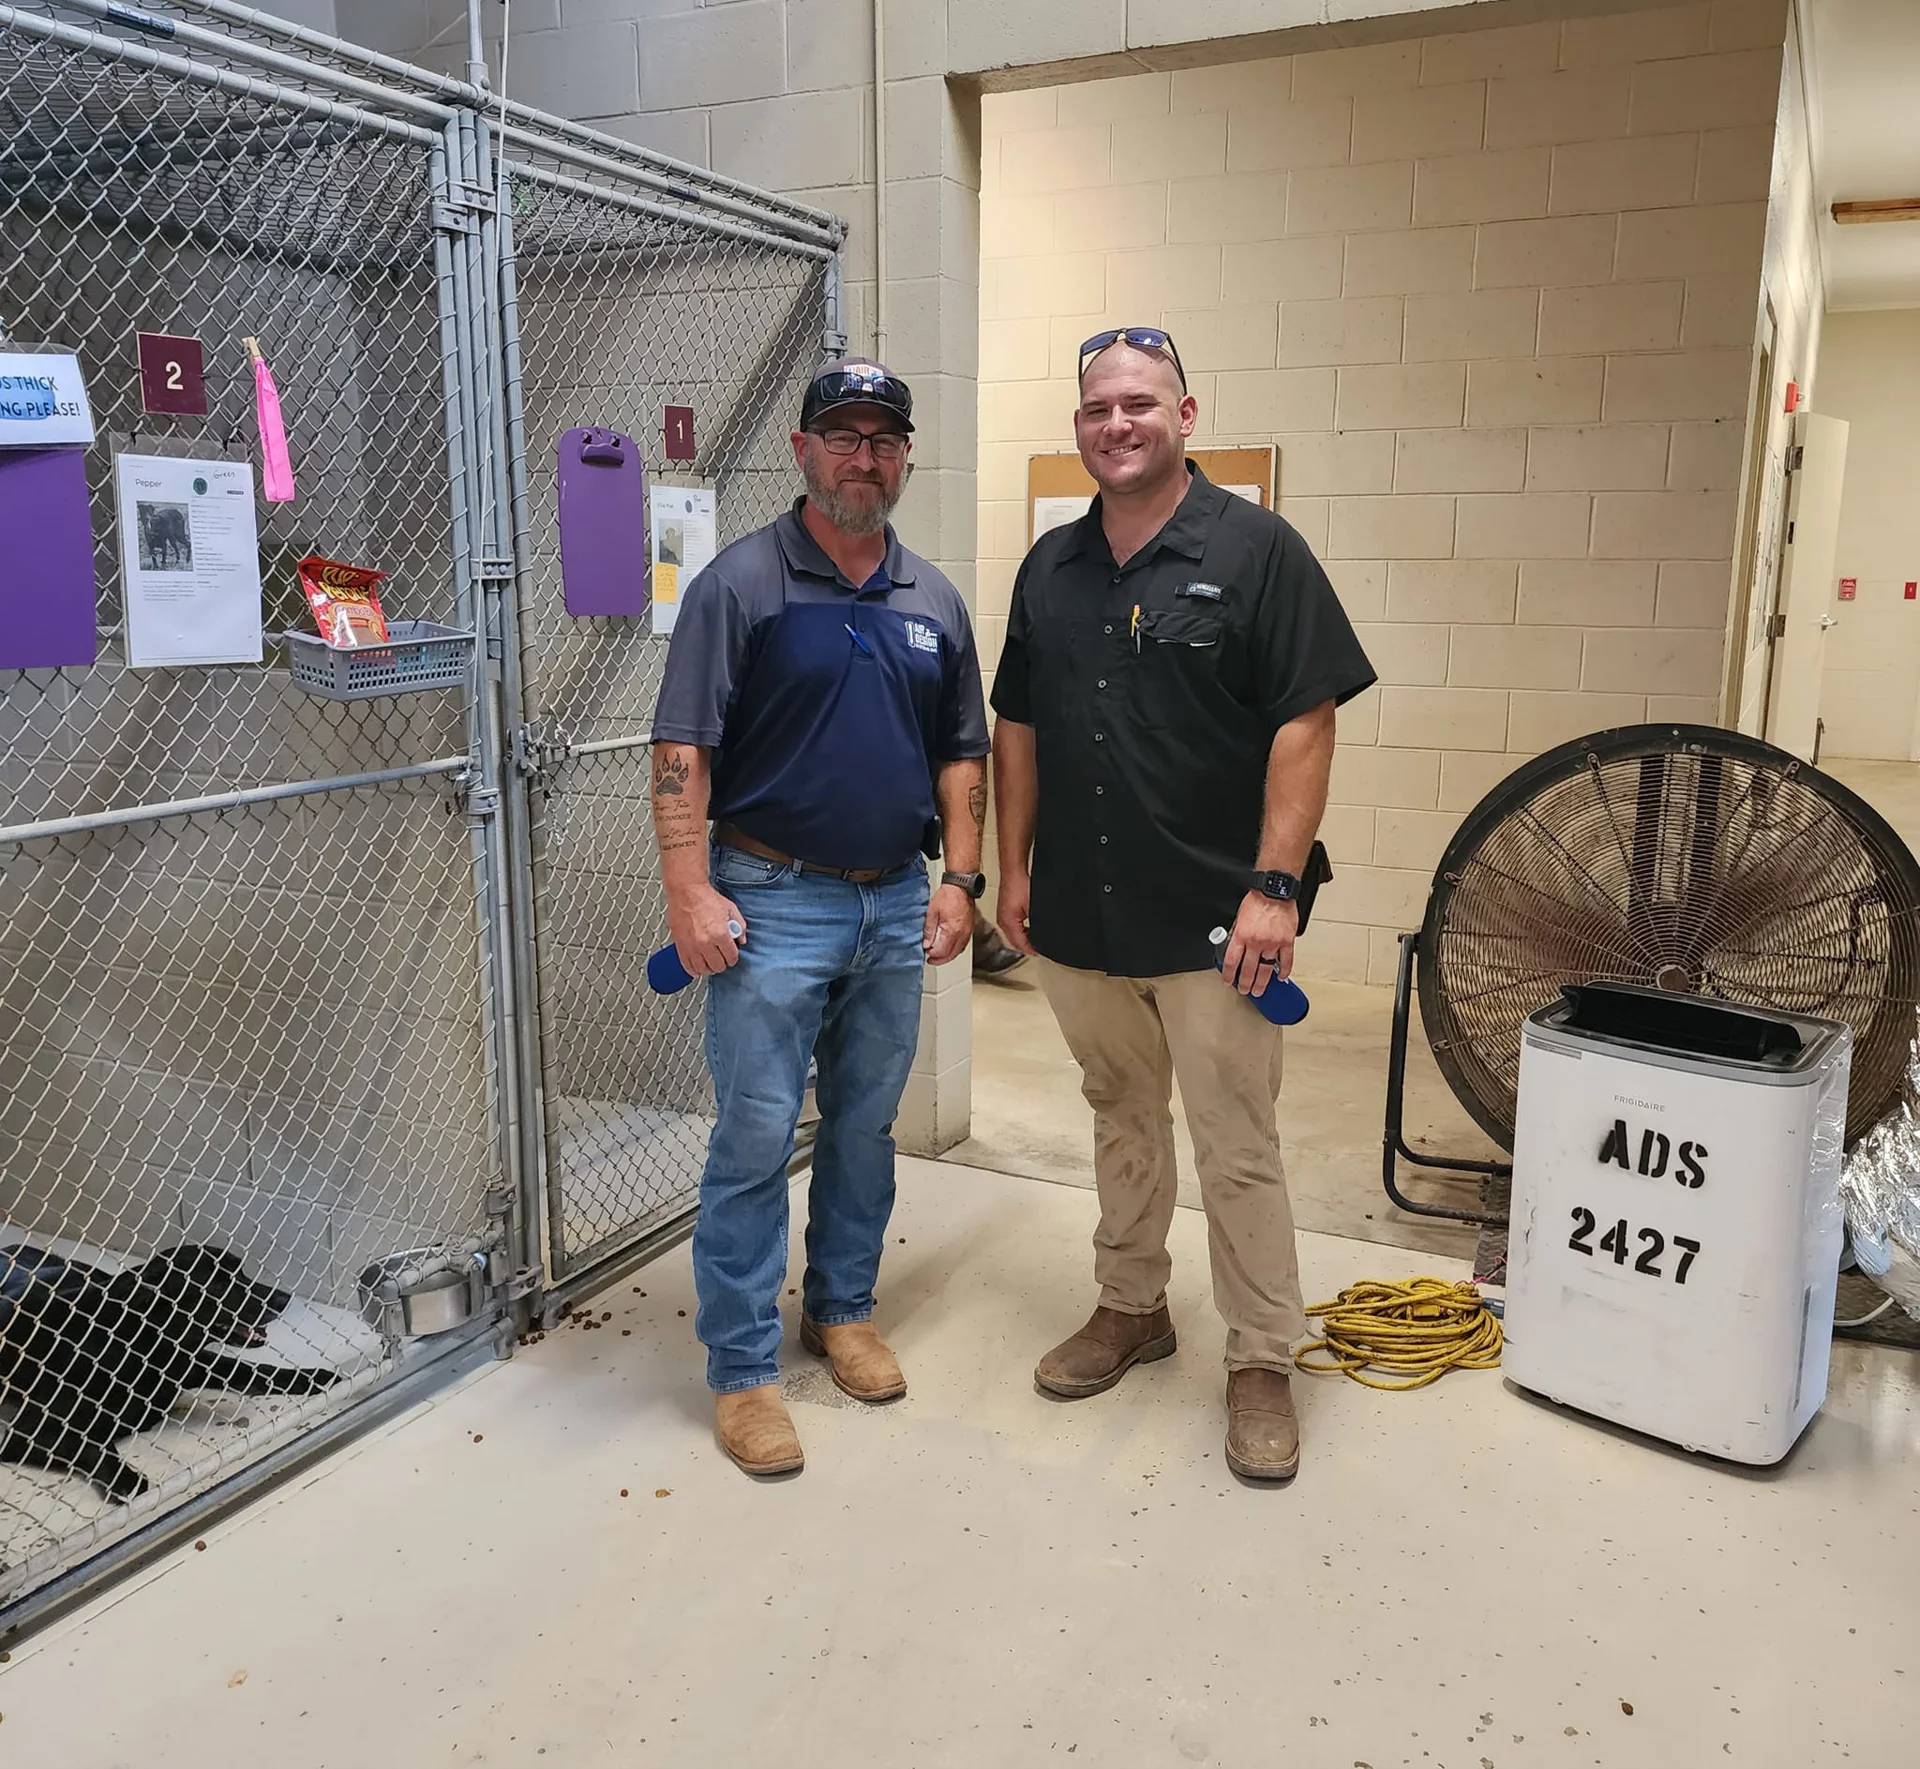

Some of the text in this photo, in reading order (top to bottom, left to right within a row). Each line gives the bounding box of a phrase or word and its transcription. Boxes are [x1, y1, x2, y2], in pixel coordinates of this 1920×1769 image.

[13, 376, 59, 391] THICK
[164, 361, 183, 390] 2
[25, 402, 81, 417] PLEASE!
[676, 419, 684, 444] 1
[135, 478, 162, 488] Pepper
[1613, 1094, 1666, 1113] FRIGIDAIRE
[1598, 1119, 1709, 1189] ADS
[1568, 1206, 1701, 1285] 2427
